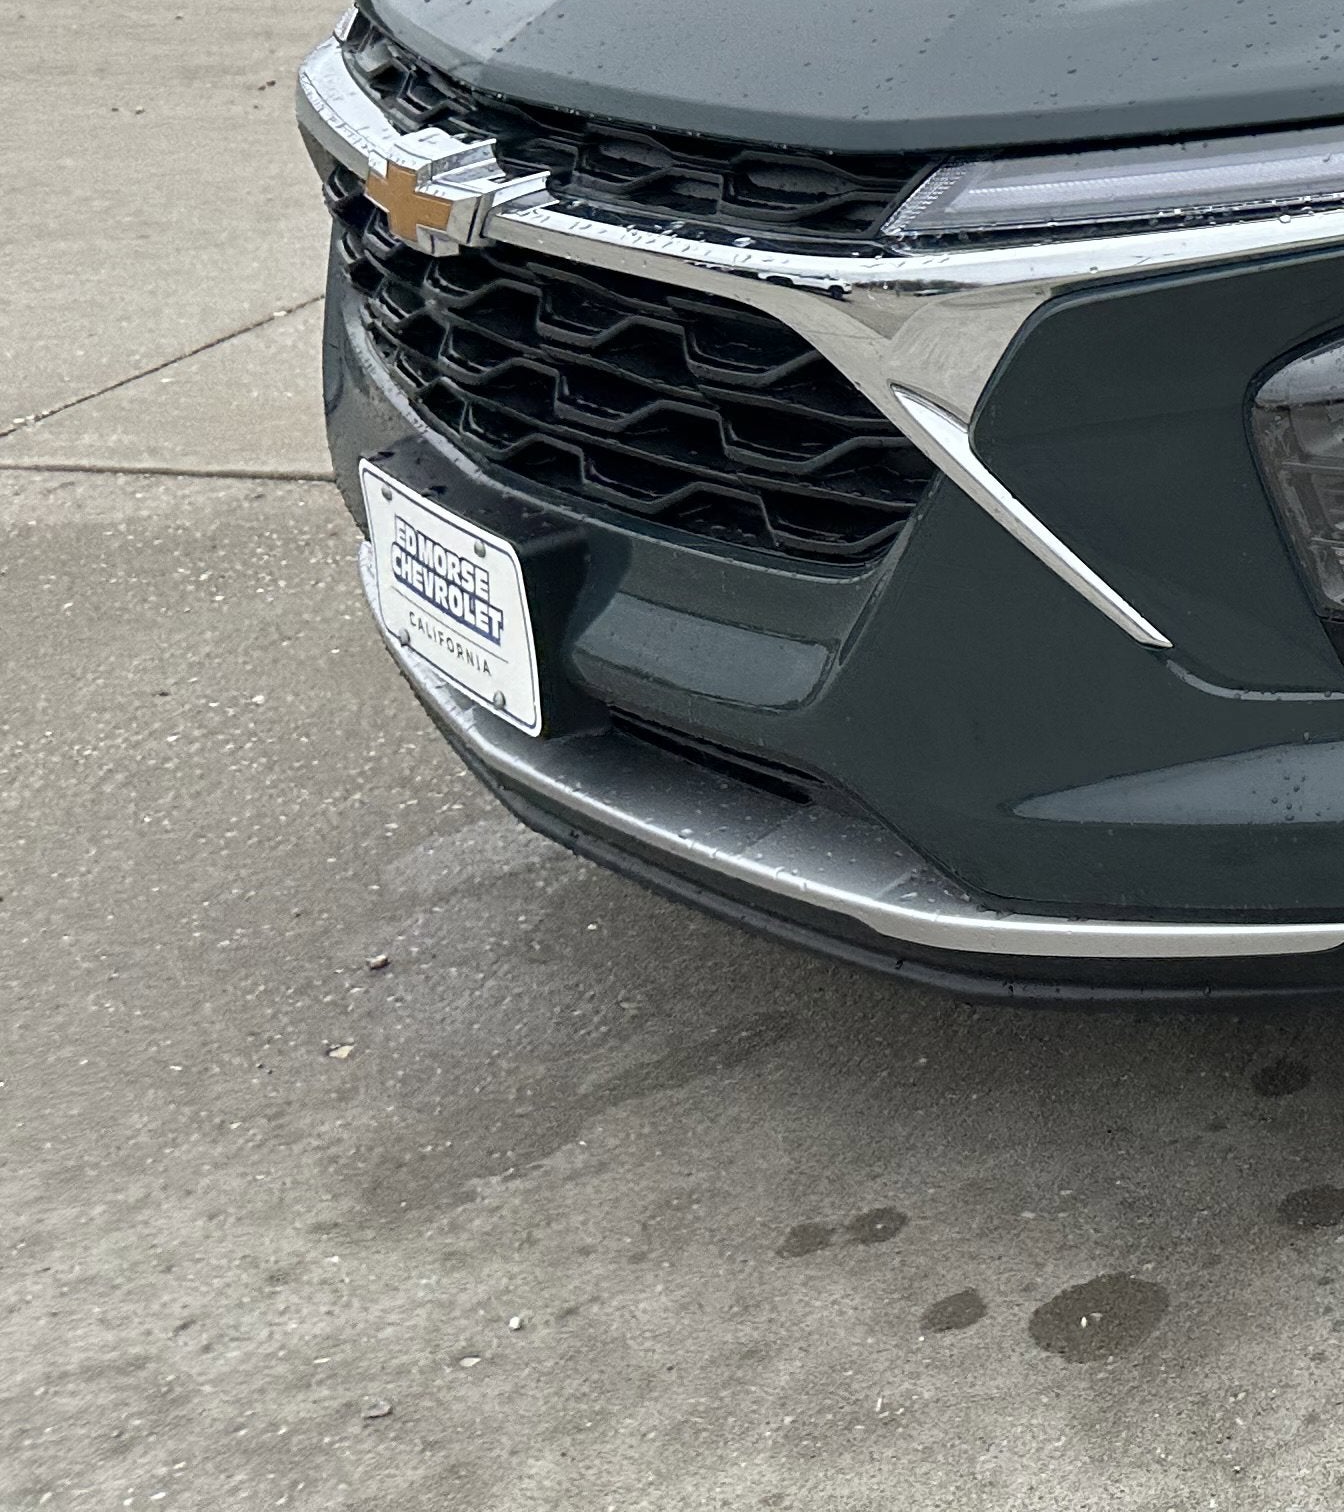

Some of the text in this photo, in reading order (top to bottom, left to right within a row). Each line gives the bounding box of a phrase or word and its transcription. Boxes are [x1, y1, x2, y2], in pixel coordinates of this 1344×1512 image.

[391, 541, 504, 646] CHEVROLET
[394, 514, 490, 604] ED MORSE
[409, 610, 492, 677] CALIFORNIA
